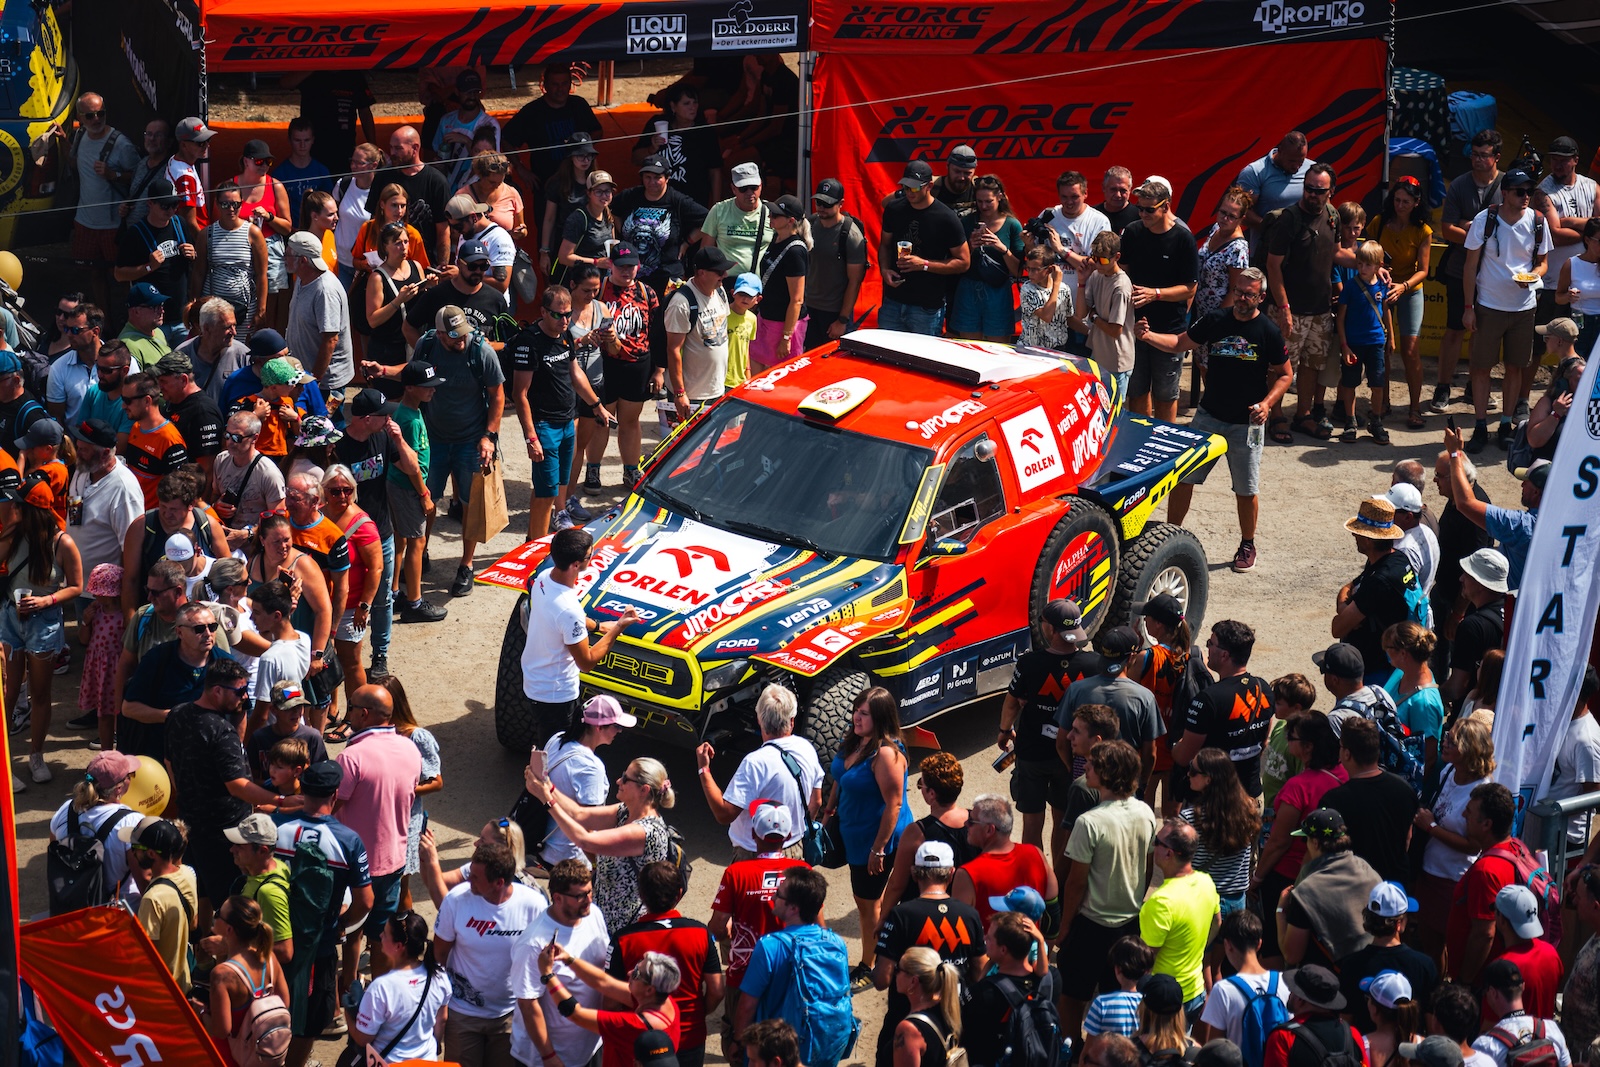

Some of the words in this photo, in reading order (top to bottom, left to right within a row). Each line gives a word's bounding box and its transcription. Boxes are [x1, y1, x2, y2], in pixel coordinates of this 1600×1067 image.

[843, 6, 994, 23] X-FORCE
[232, 24, 390, 44] X-FORCE
[630, 17, 683, 34] LIQUI
[717, 23, 741, 35] DR.
[745, 22, 791, 34] DOERR
[860, 25, 960, 39] RACING
[629, 36, 683, 53] MOLY
[736, 37, 788, 45] Leckermacher
[251, 44, 355, 60] RACING
[879, 101, 1134, 135] X-FORCE
[909, 135, 1074, 161] RACING
[474, 309, 488, 324] RIDE
[701, 308, 718, 319] TATRA
[920, 399, 984, 440] JIPOCAR
[1057, 405, 1079, 436] verva
[1071, 407, 1107, 475] JIPOCAR
[1024, 455, 1055, 477] ORLEN
[1123, 486, 1146, 510] FORD
[1060, 544, 1089, 573] ALPHA
[613, 570, 710, 605] ORLEN
[682, 581, 775, 640] JIPOCAR
[778, 599, 832, 628] verva
[716, 638, 760, 649] FORD
[774, 653, 817, 671] ALPHA
[990, 651, 1012, 662] SATUM
[947, 682, 955, 690] PJ
[955, 677, 974, 687] Group
[1510, 1010, 1525, 1018] SONY
